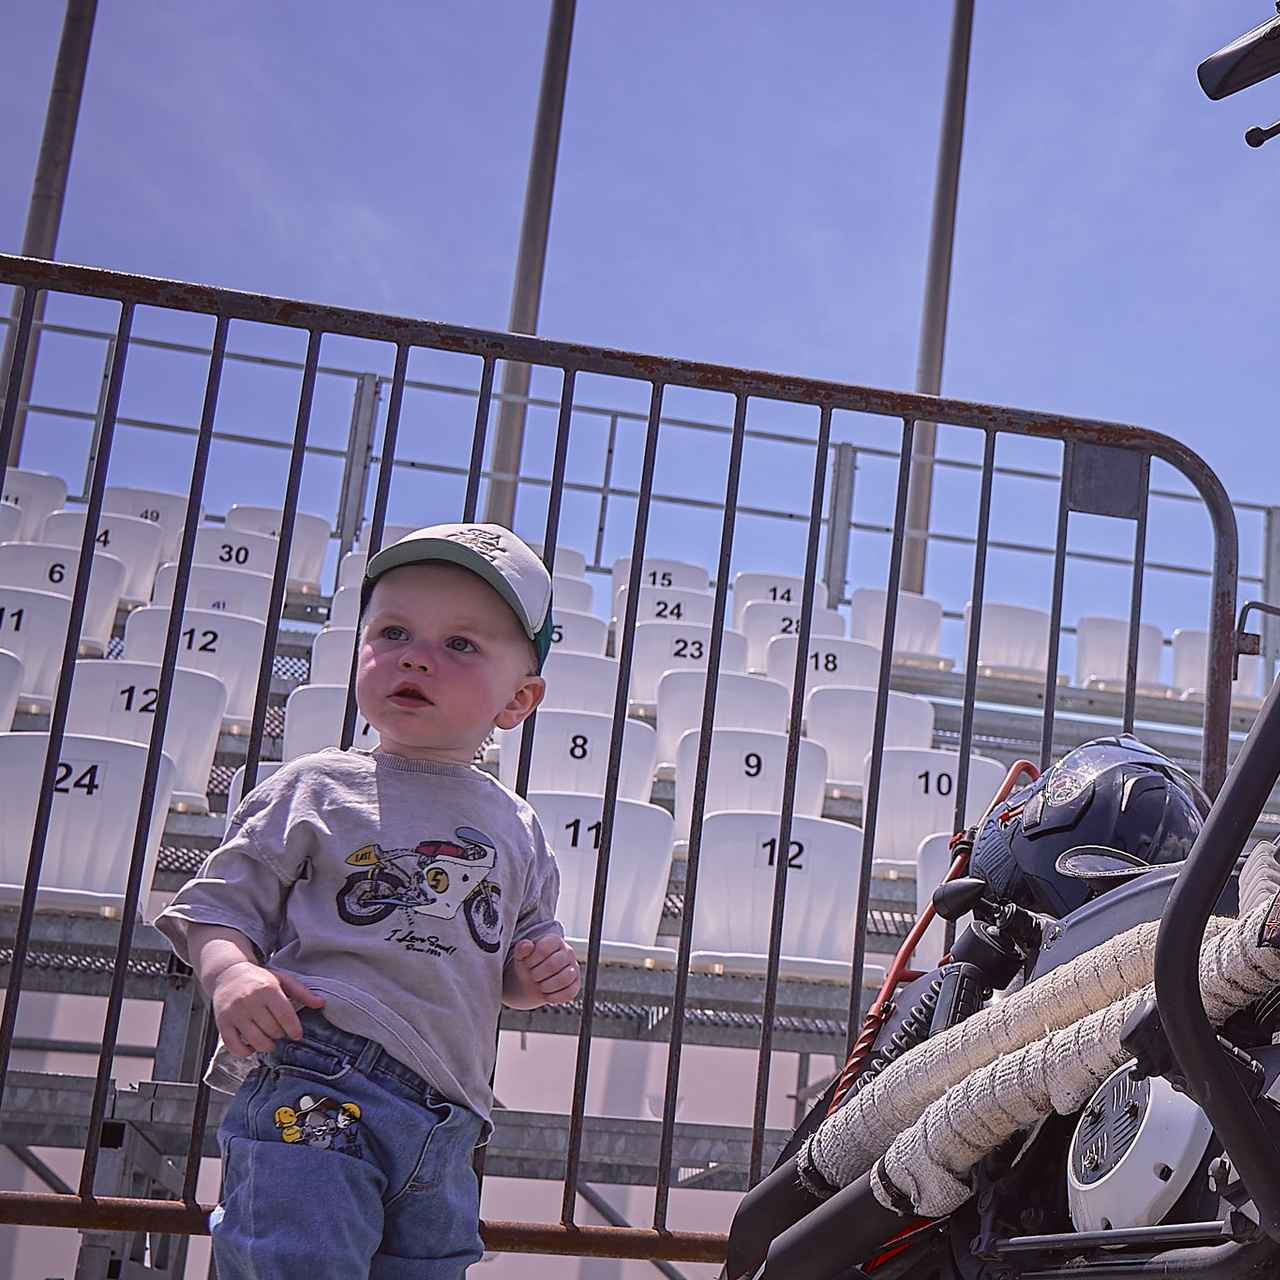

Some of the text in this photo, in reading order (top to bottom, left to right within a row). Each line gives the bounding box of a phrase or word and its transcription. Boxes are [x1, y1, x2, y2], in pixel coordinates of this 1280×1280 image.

[218, 544, 250, 565] 30
[48, 563, 66, 584] 6
[648, 570, 673, 588] 15
[768, 586, 792, 602] 14
[655, 600, 683, 620] 24
[181, 627, 219, 654] 12
[673, 638, 704, 660] 23
[809, 651, 838, 673] 18
[120, 685, 159, 714] 12
[569, 734, 589, 760] 8
[744, 753, 763, 778] 9
[53, 762, 99, 796] 24
[917, 770, 953, 797] 10
[564, 817, 603, 850] 11
[354, 851, 373, 863] EAST
[761, 837, 805, 870] 12
[429, 870, 445, 890] 5
